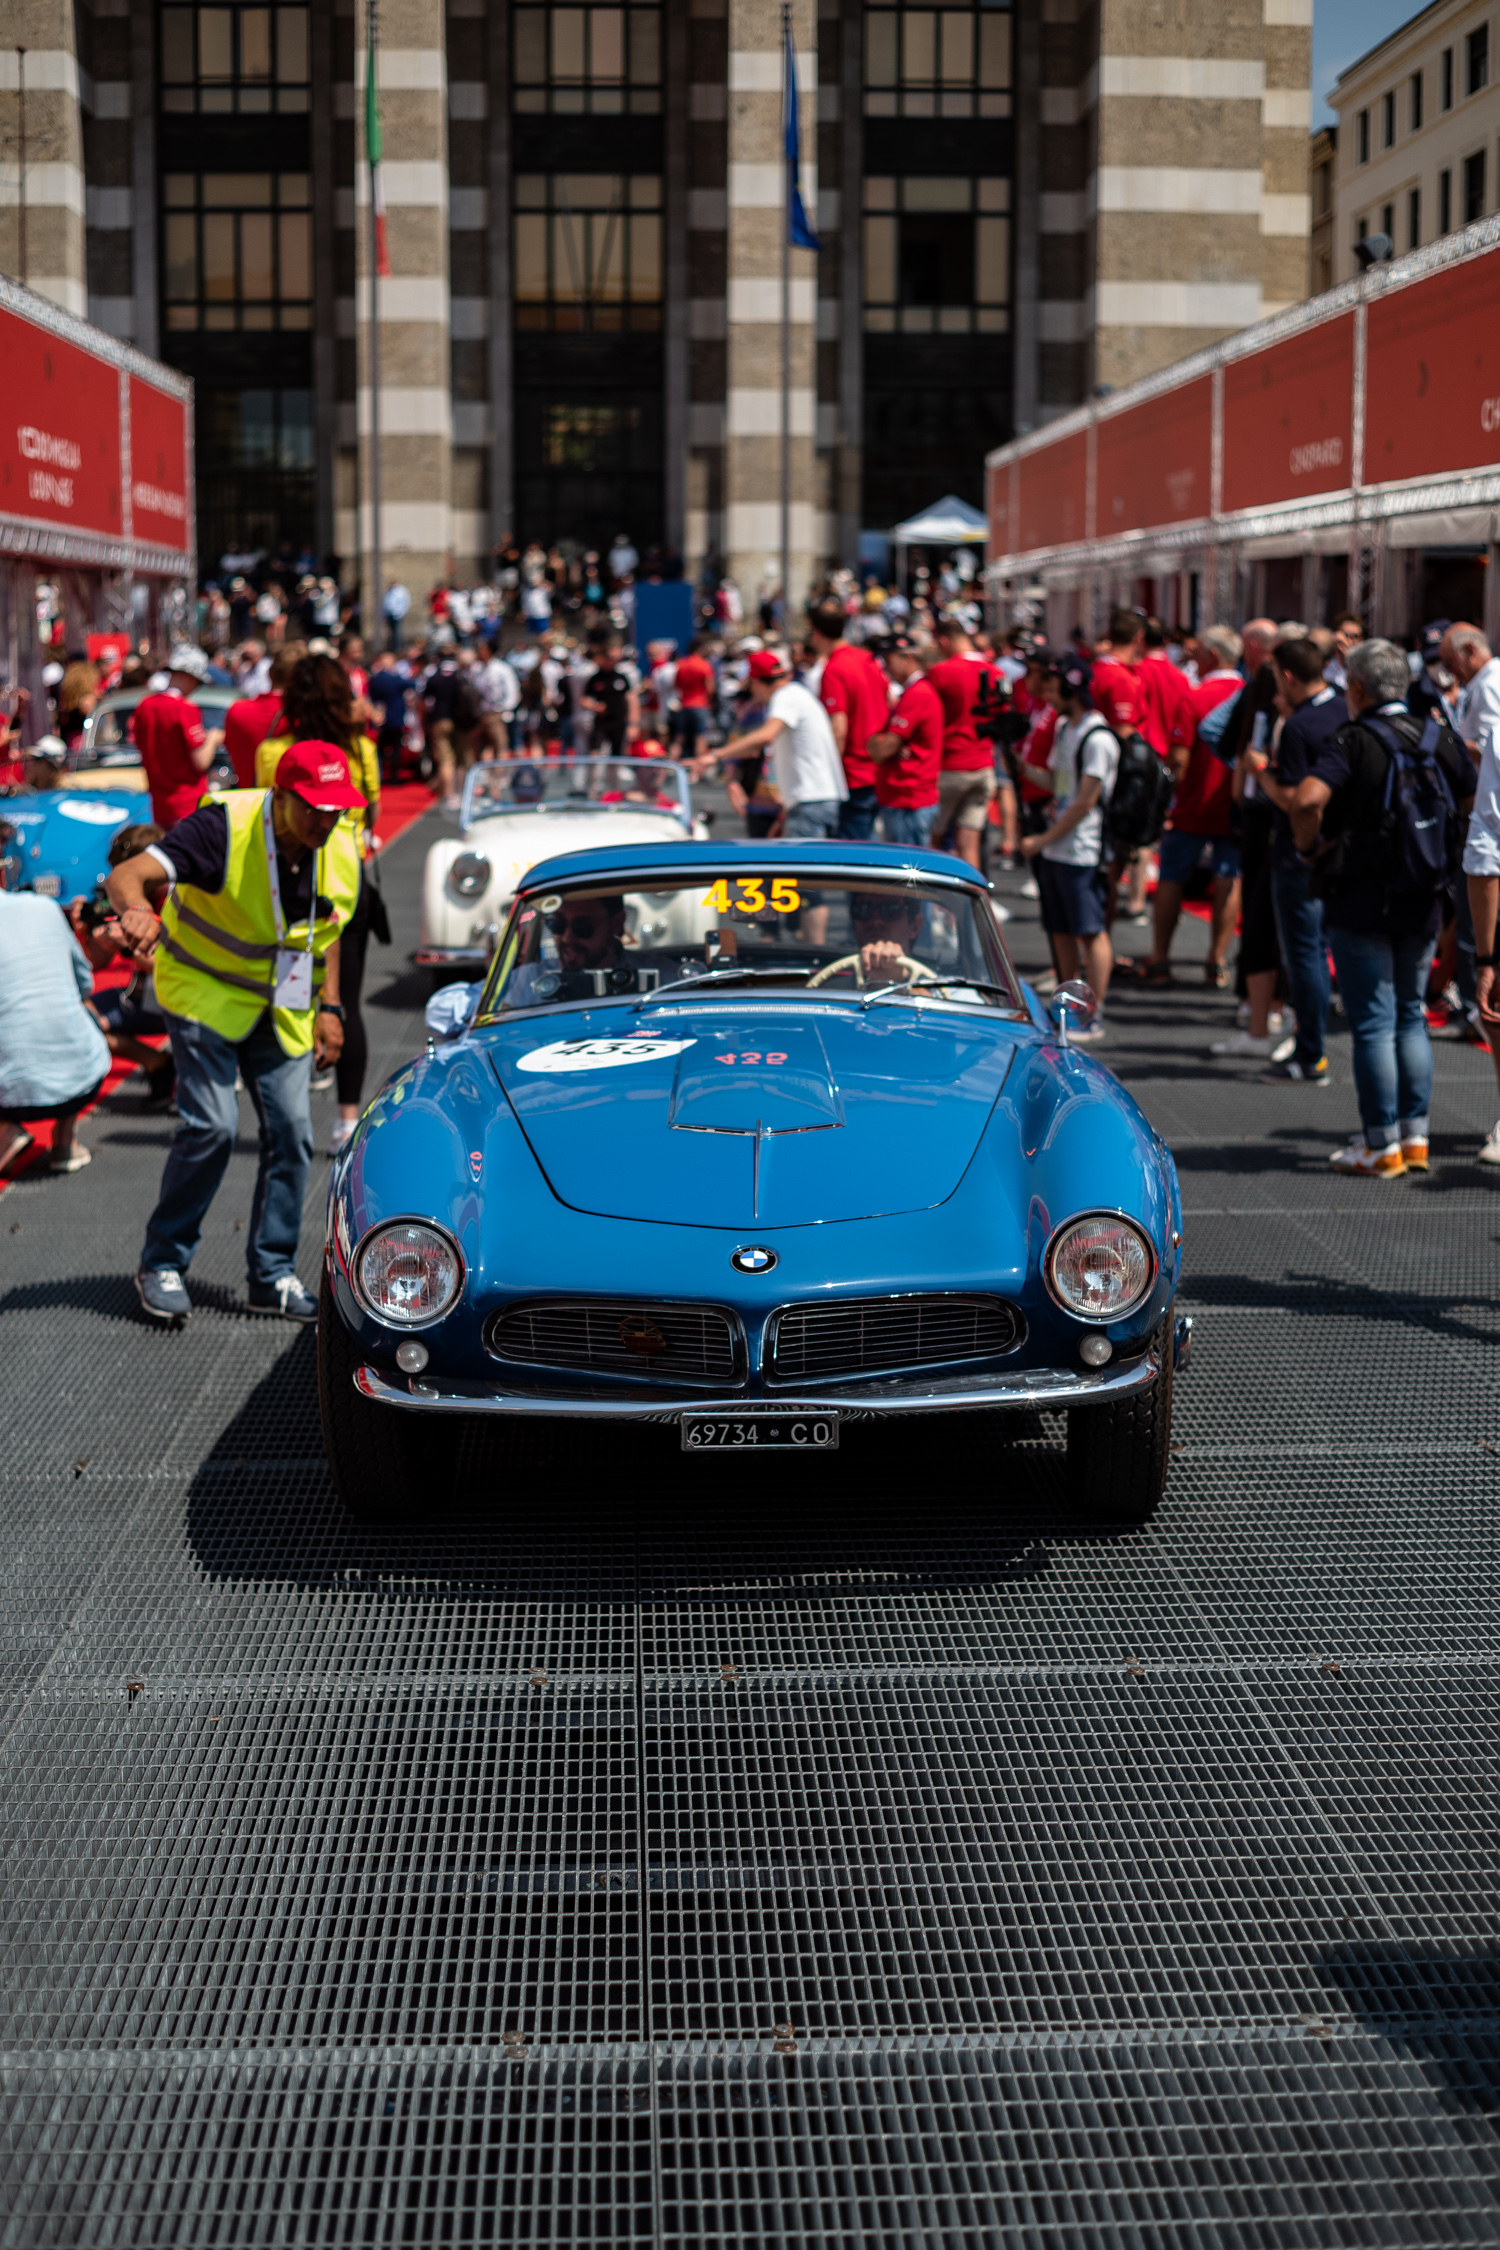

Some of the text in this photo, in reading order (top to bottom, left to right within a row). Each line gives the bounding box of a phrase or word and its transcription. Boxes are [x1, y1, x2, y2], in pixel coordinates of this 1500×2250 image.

[701, 878, 800, 913] 435
[551, 1042, 668, 1056] 435
[689, 1423, 829, 1445] 69734 CO
